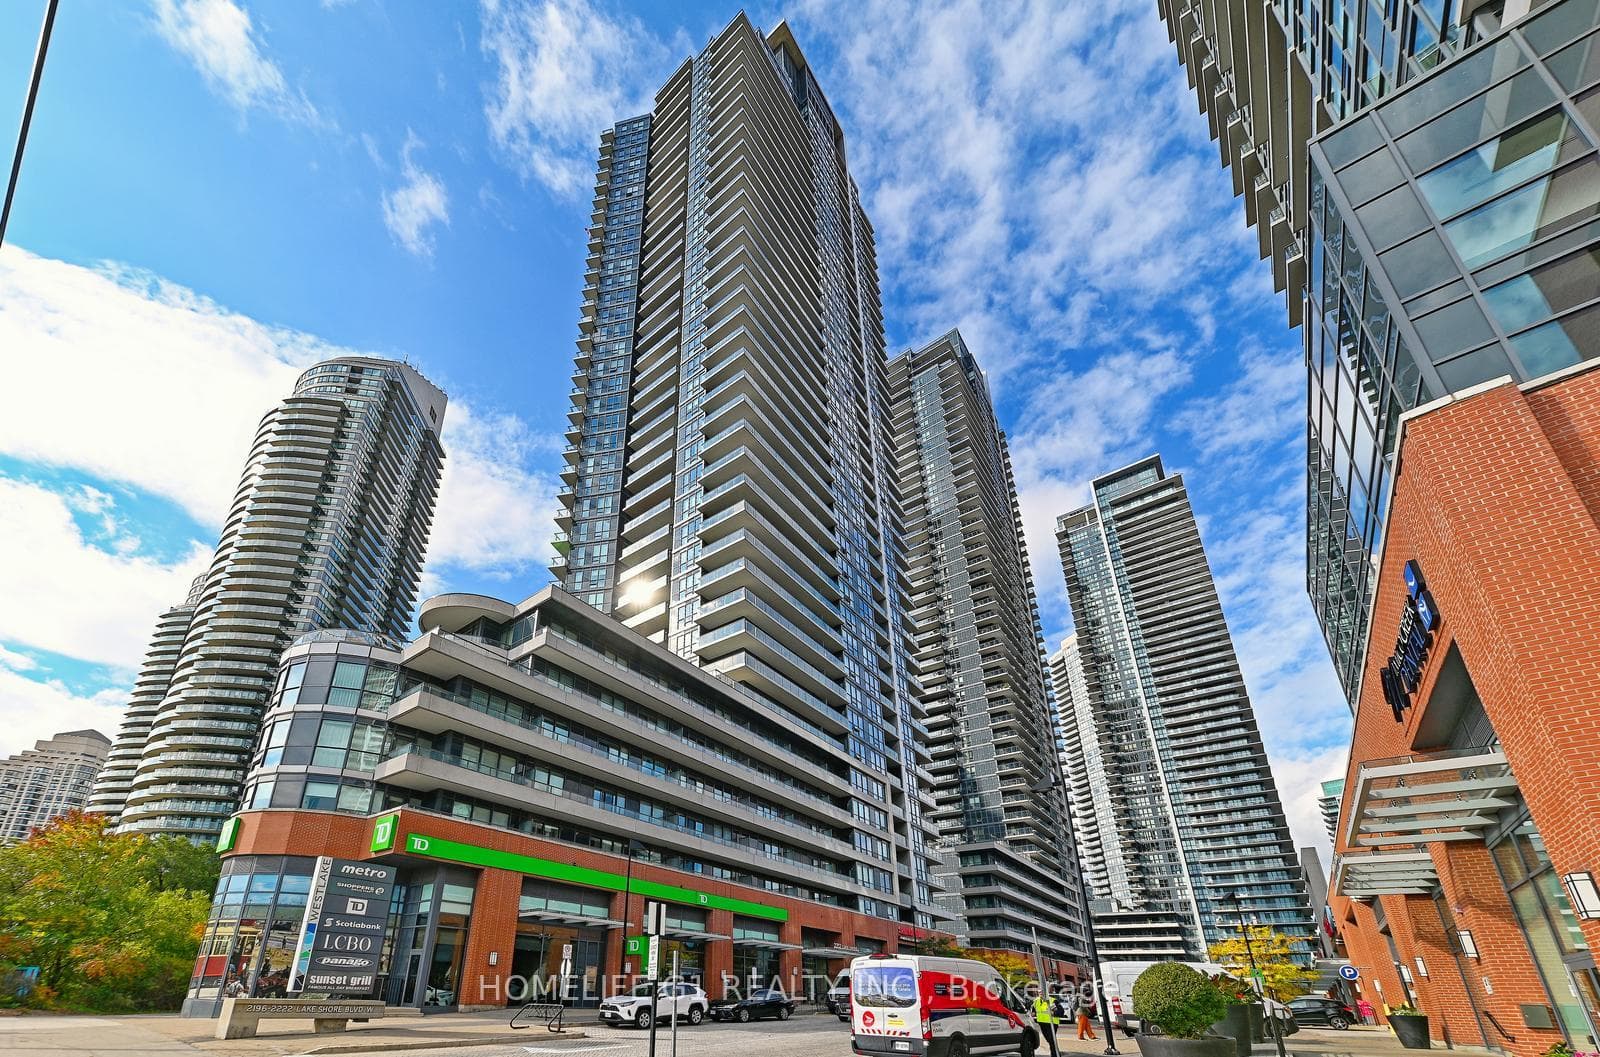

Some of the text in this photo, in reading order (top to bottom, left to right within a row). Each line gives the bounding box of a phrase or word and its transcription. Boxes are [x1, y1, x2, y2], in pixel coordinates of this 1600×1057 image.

[376, 822, 391, 844] TD
[411, 837, 429, 851] TD
[341, 864, 387, 879] metro
[309, 858, 331, 921] WESTLAKE
[336, 882, 375, 891] SHOPPERS
[699, 894, 708, 904] TD
[350, 900, 365, 912] TD
[335, 919, 382, 930] Scotiabank
[323, 934, 372, 952] LCBO
[628, 940, 640, 952] TD
[321, 957, 370, 967] panago
[309, 975, 372, 987] sunset grill
[246, 1005, 294, 1013] 2196-2222
[296, 1005, 317, 1013] LAKE
[318, 1005, 342, 1013] SHORE
